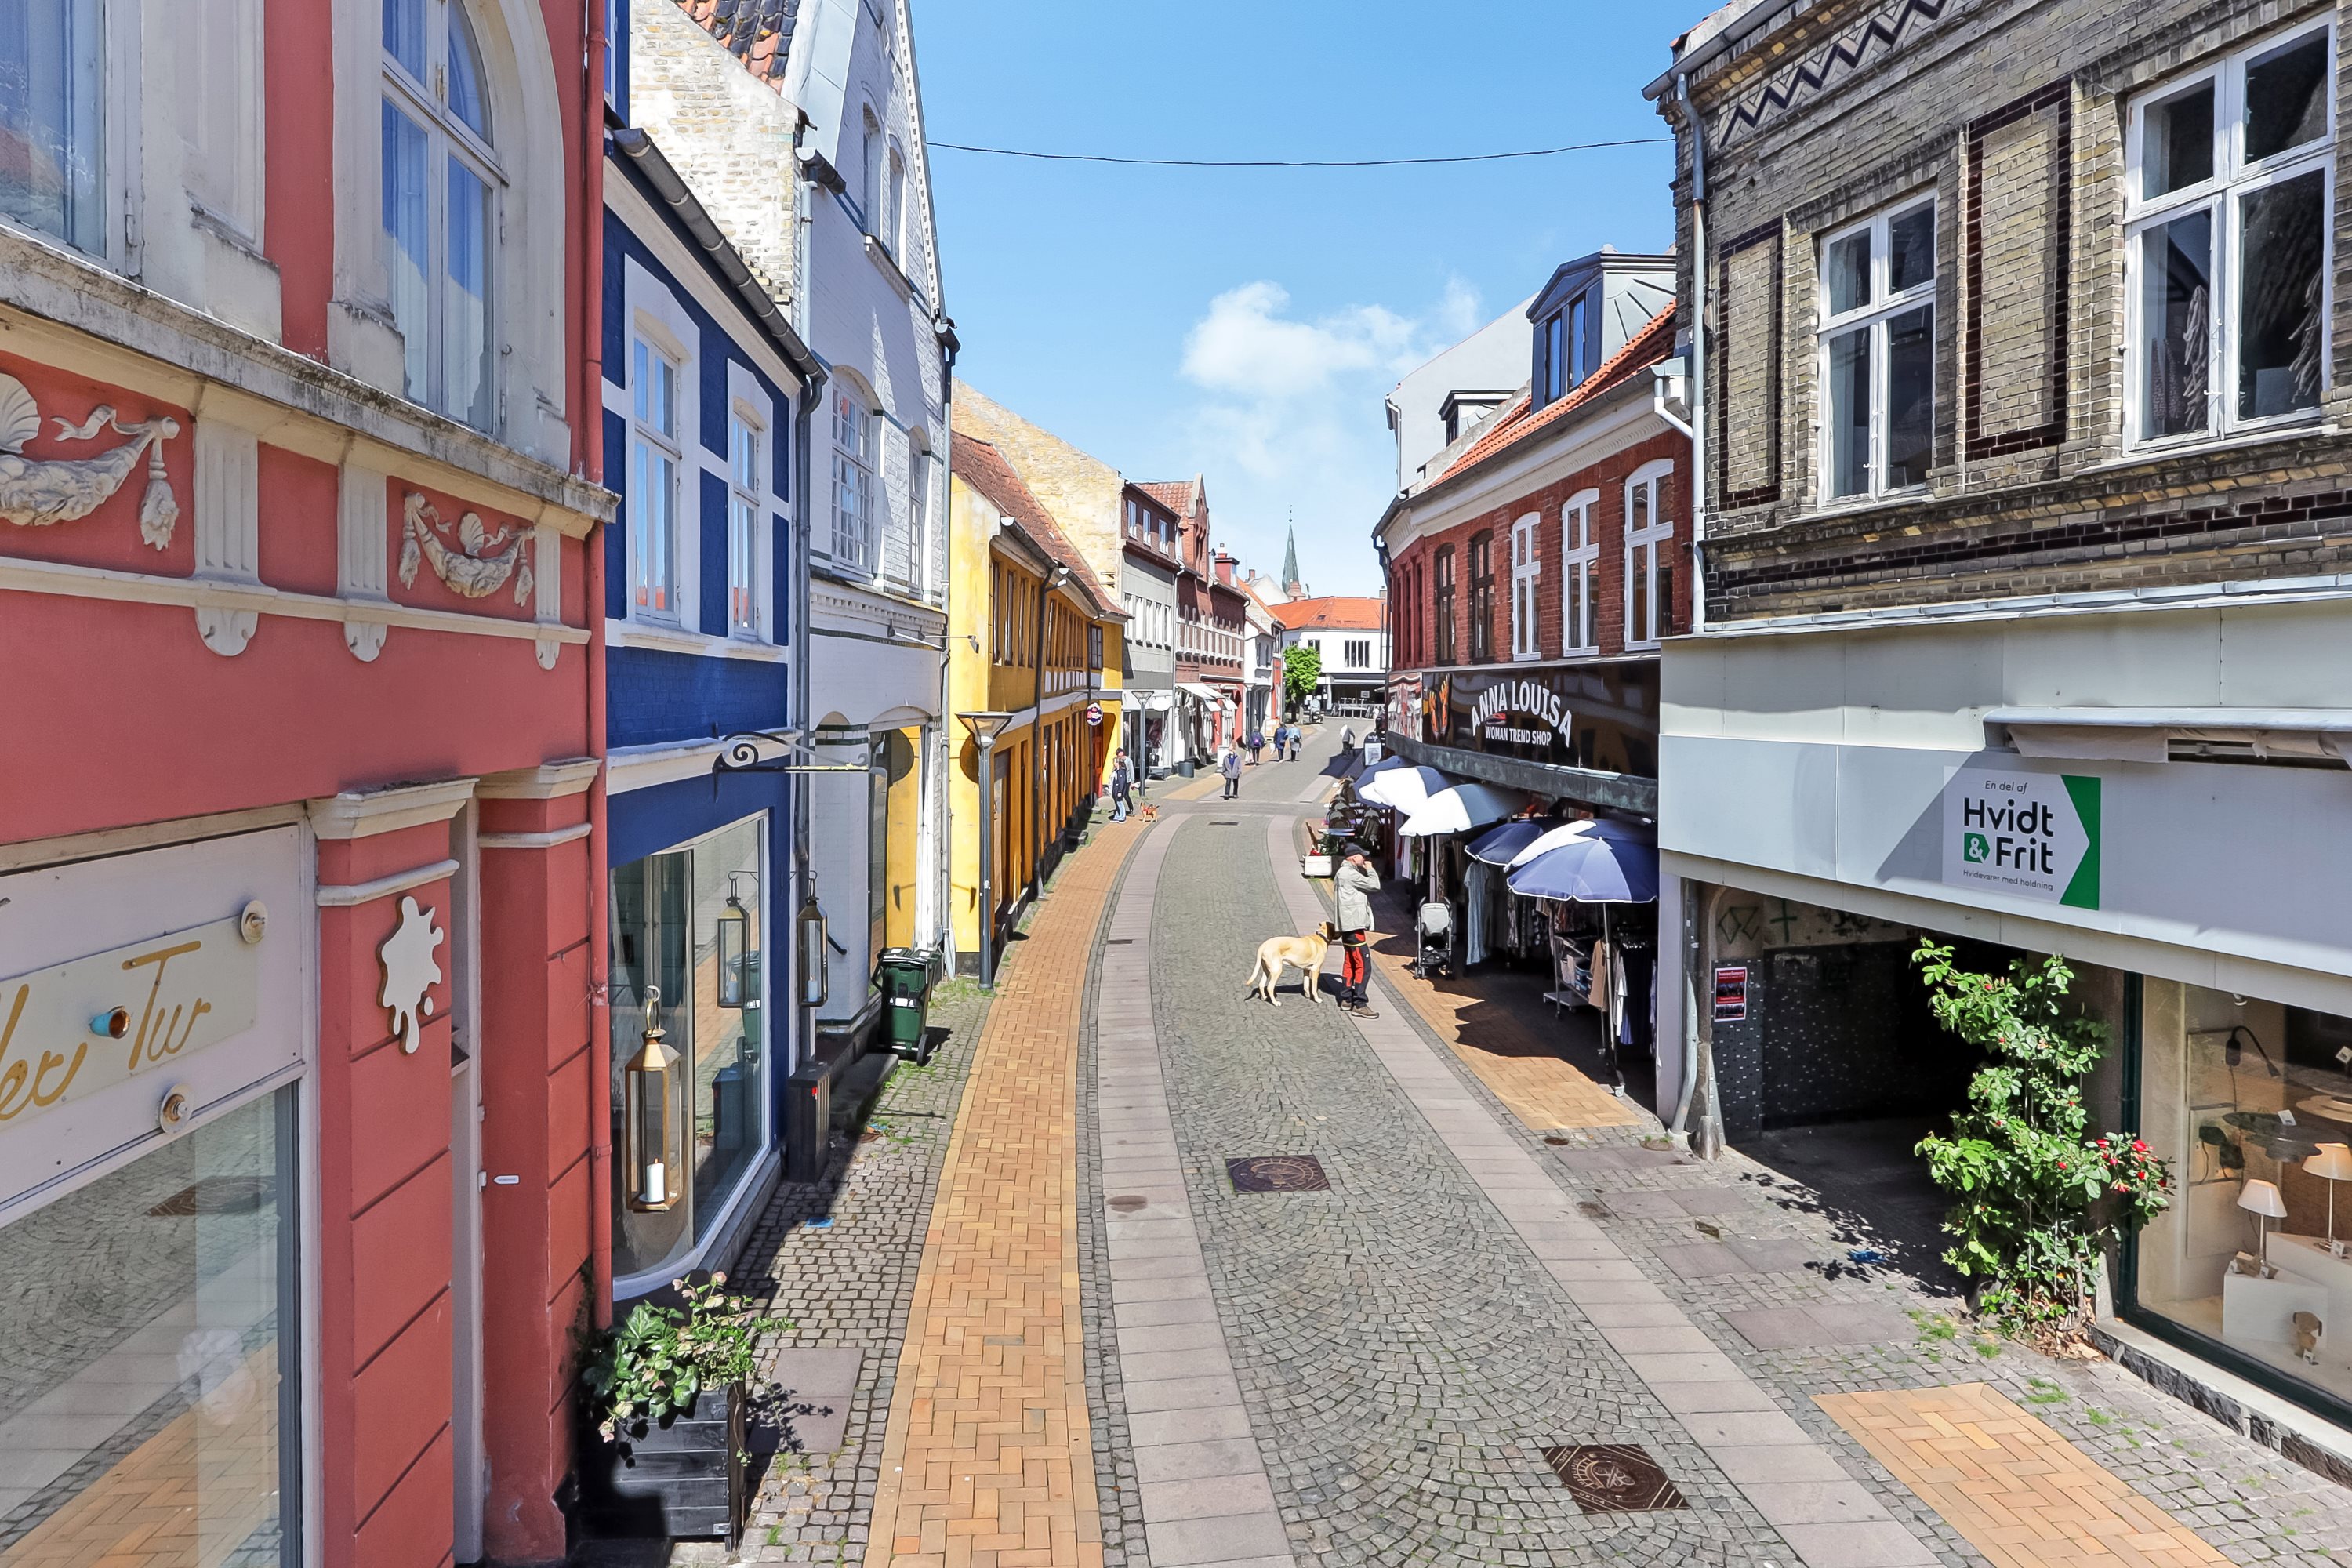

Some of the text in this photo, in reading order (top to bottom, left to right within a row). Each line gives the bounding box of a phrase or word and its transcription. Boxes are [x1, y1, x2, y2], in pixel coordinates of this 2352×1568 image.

[1471, 681, 1572, 748] ANNA LOUISA
[1486, 725, 1552, 746] WOMAN TREND SHOP
[1985, 781, 2027, 794] En del af
[1964, 797, 2054, 837] Hvidt
[1969, 836, 2053, 874] & Frit
[1963, 869, 2053, 891] Hvidevarer med holdning
[122, 940, 212, 1071] Tur
